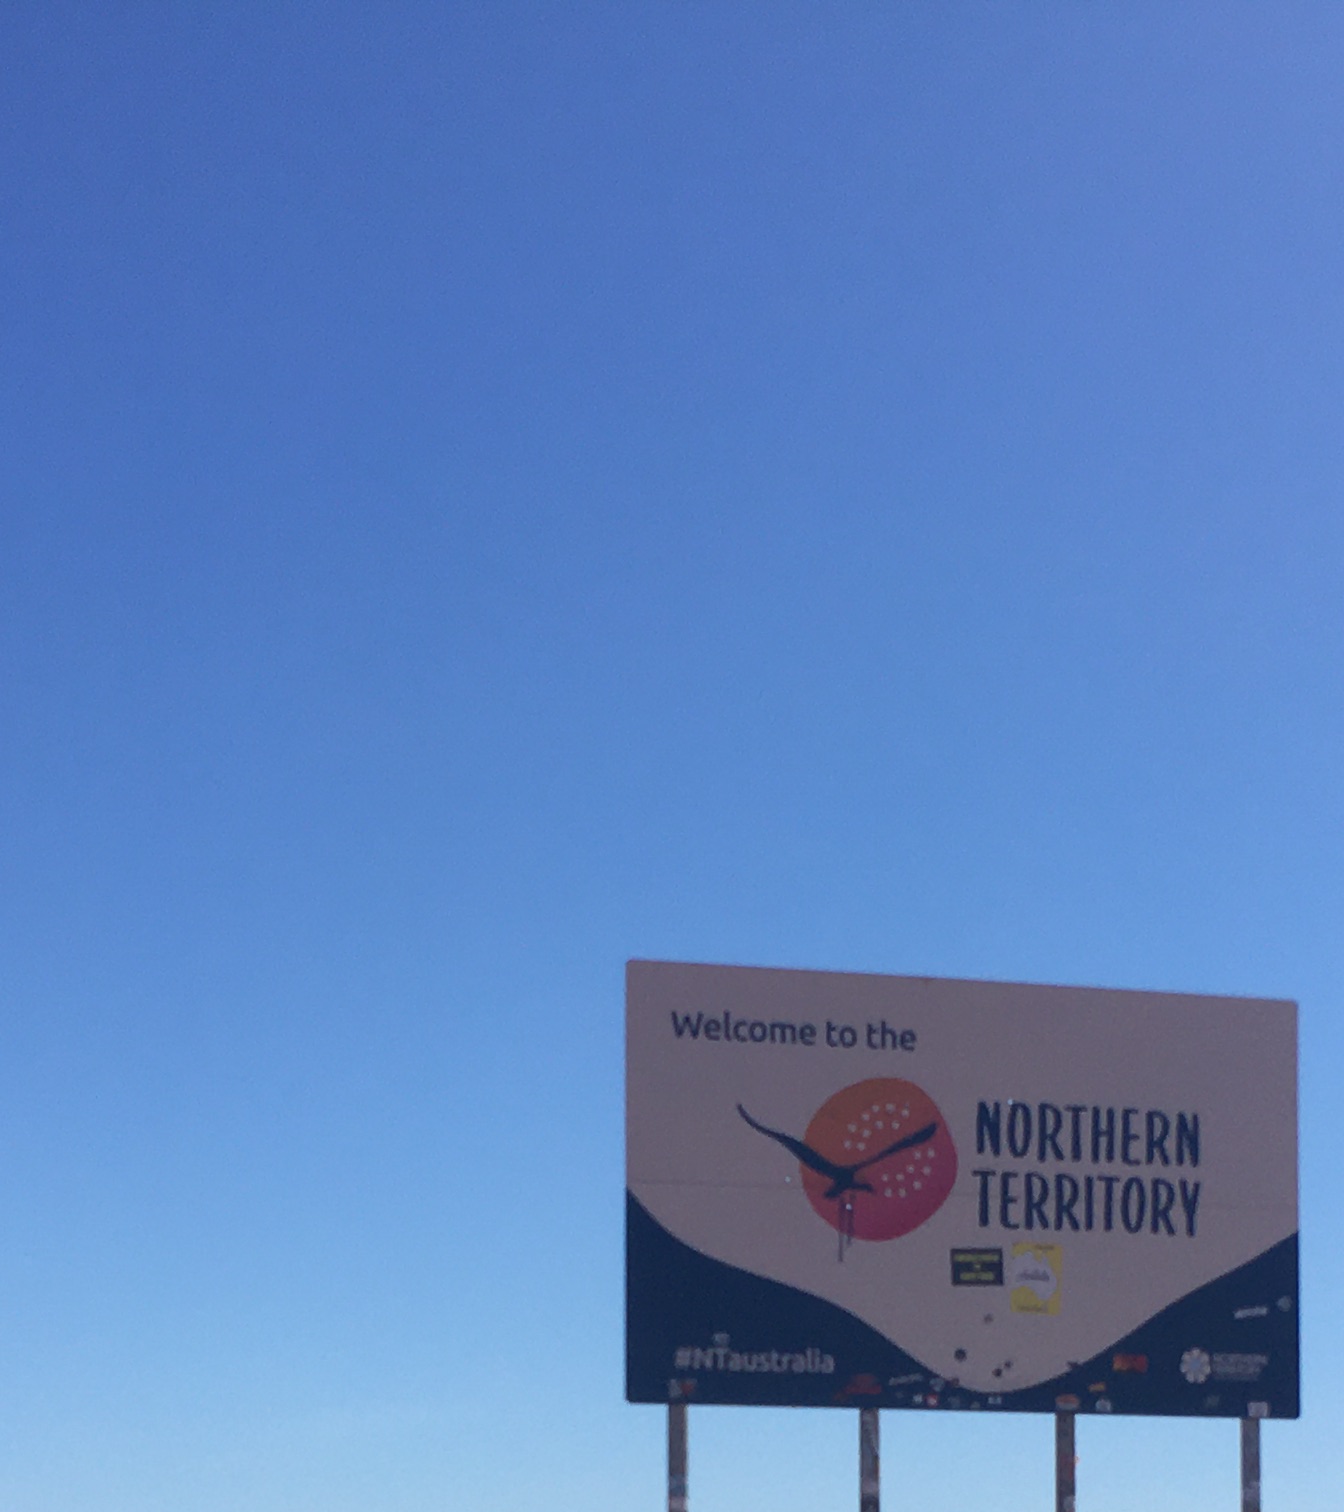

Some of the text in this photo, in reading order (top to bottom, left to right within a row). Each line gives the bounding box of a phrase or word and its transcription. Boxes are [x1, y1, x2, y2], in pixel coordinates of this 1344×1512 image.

[671, 1009, 917, 1052] Welcome to the
[976, 1101, 1200, 1167] NORTHERN
[972, 1169, 1200, 1237] TERRITORY
[674, 1346, 836, 1375] #NTaustralia
